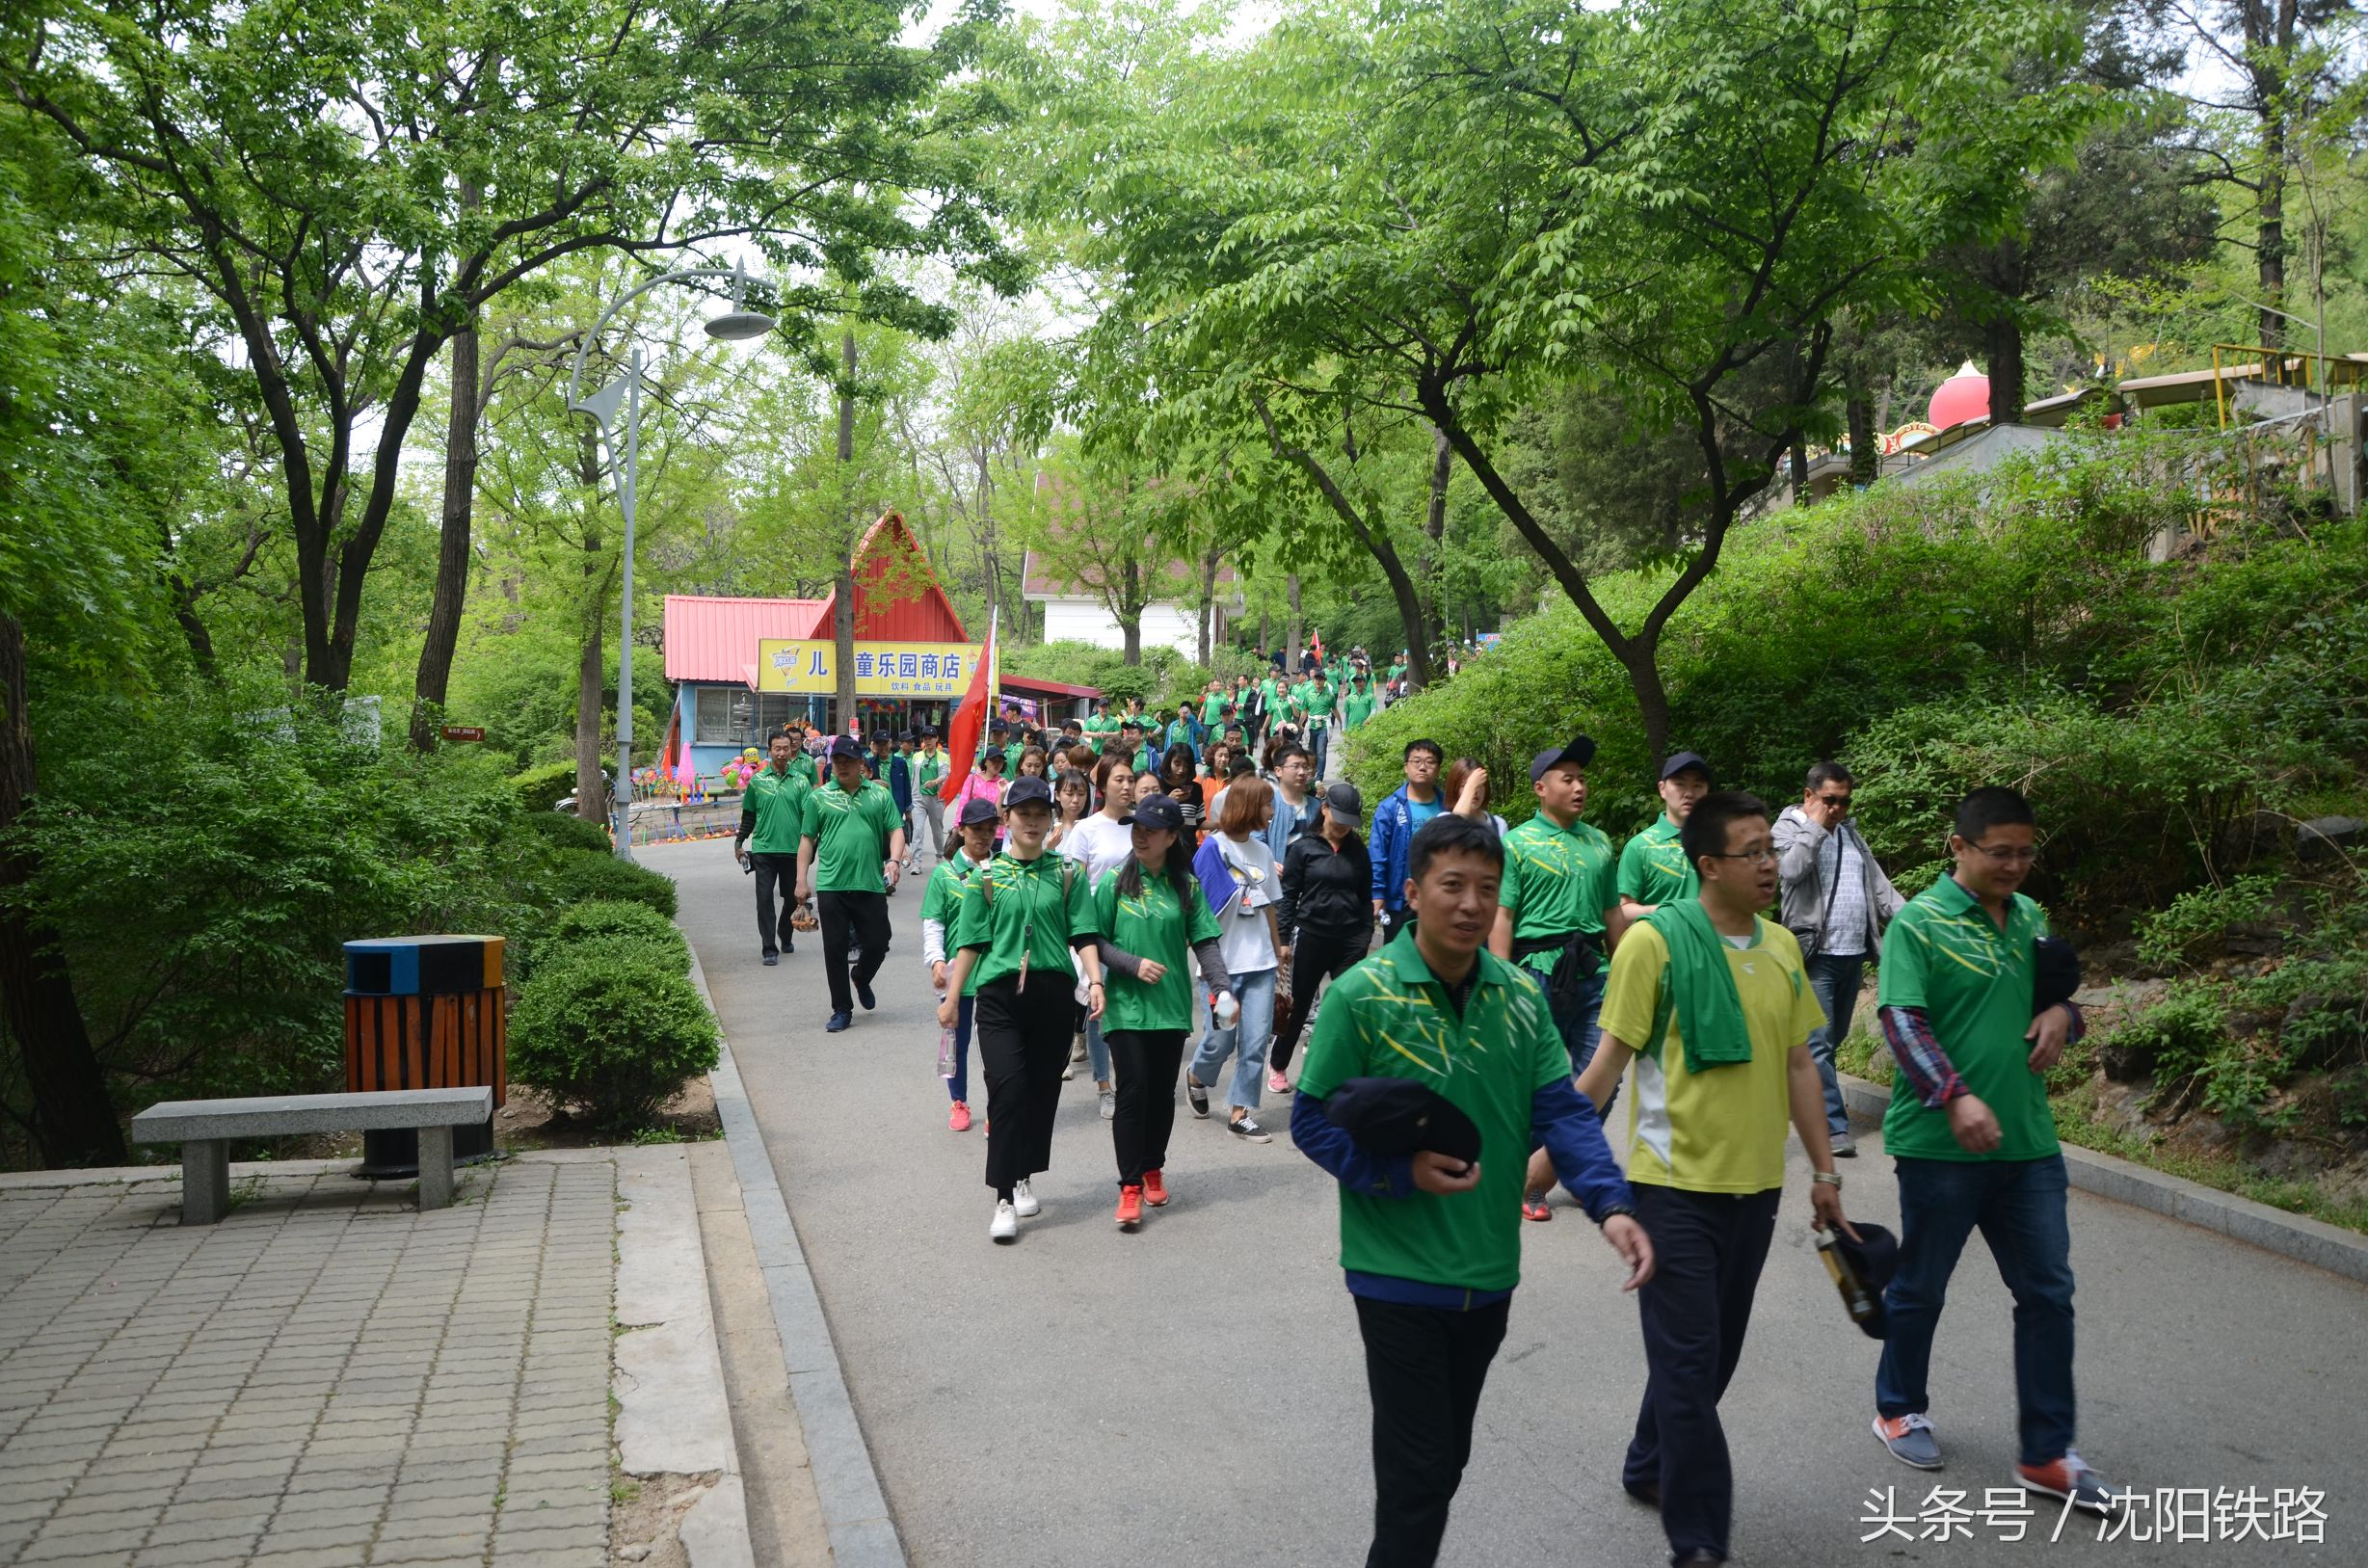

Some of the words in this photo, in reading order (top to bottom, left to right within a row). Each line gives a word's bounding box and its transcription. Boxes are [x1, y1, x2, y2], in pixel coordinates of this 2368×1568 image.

[891, 681, 910, 692] 饮料
[914, 681, 932, 692] 食品
[935, 682, 953, 693] 玩具
